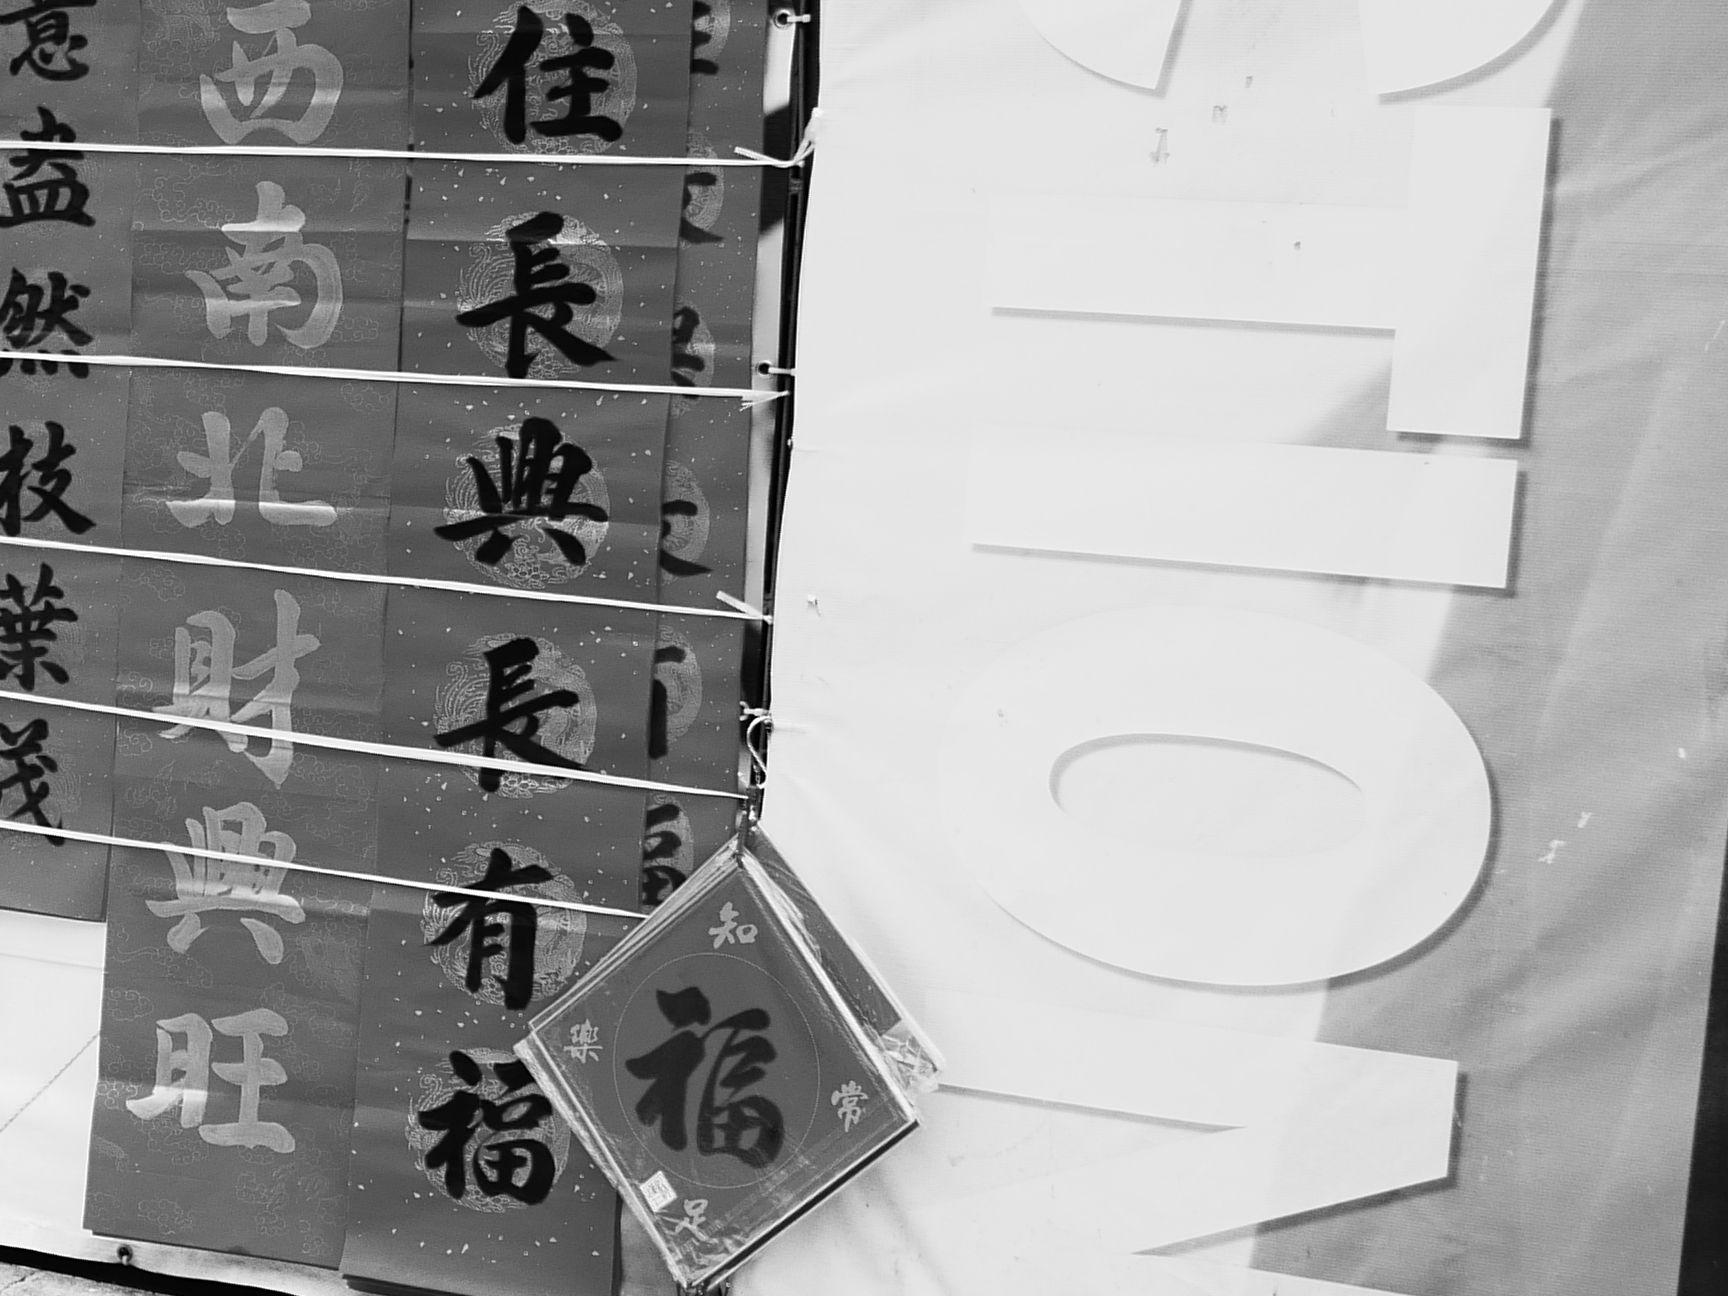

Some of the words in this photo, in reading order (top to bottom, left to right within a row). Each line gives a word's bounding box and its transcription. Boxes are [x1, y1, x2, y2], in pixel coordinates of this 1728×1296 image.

[709, 901, 759, 950] 知
[563, 1018, 603, 1064] 樂
[624, 986, 785, 1169] 福
[830, 1080, 869, 1132] 常
